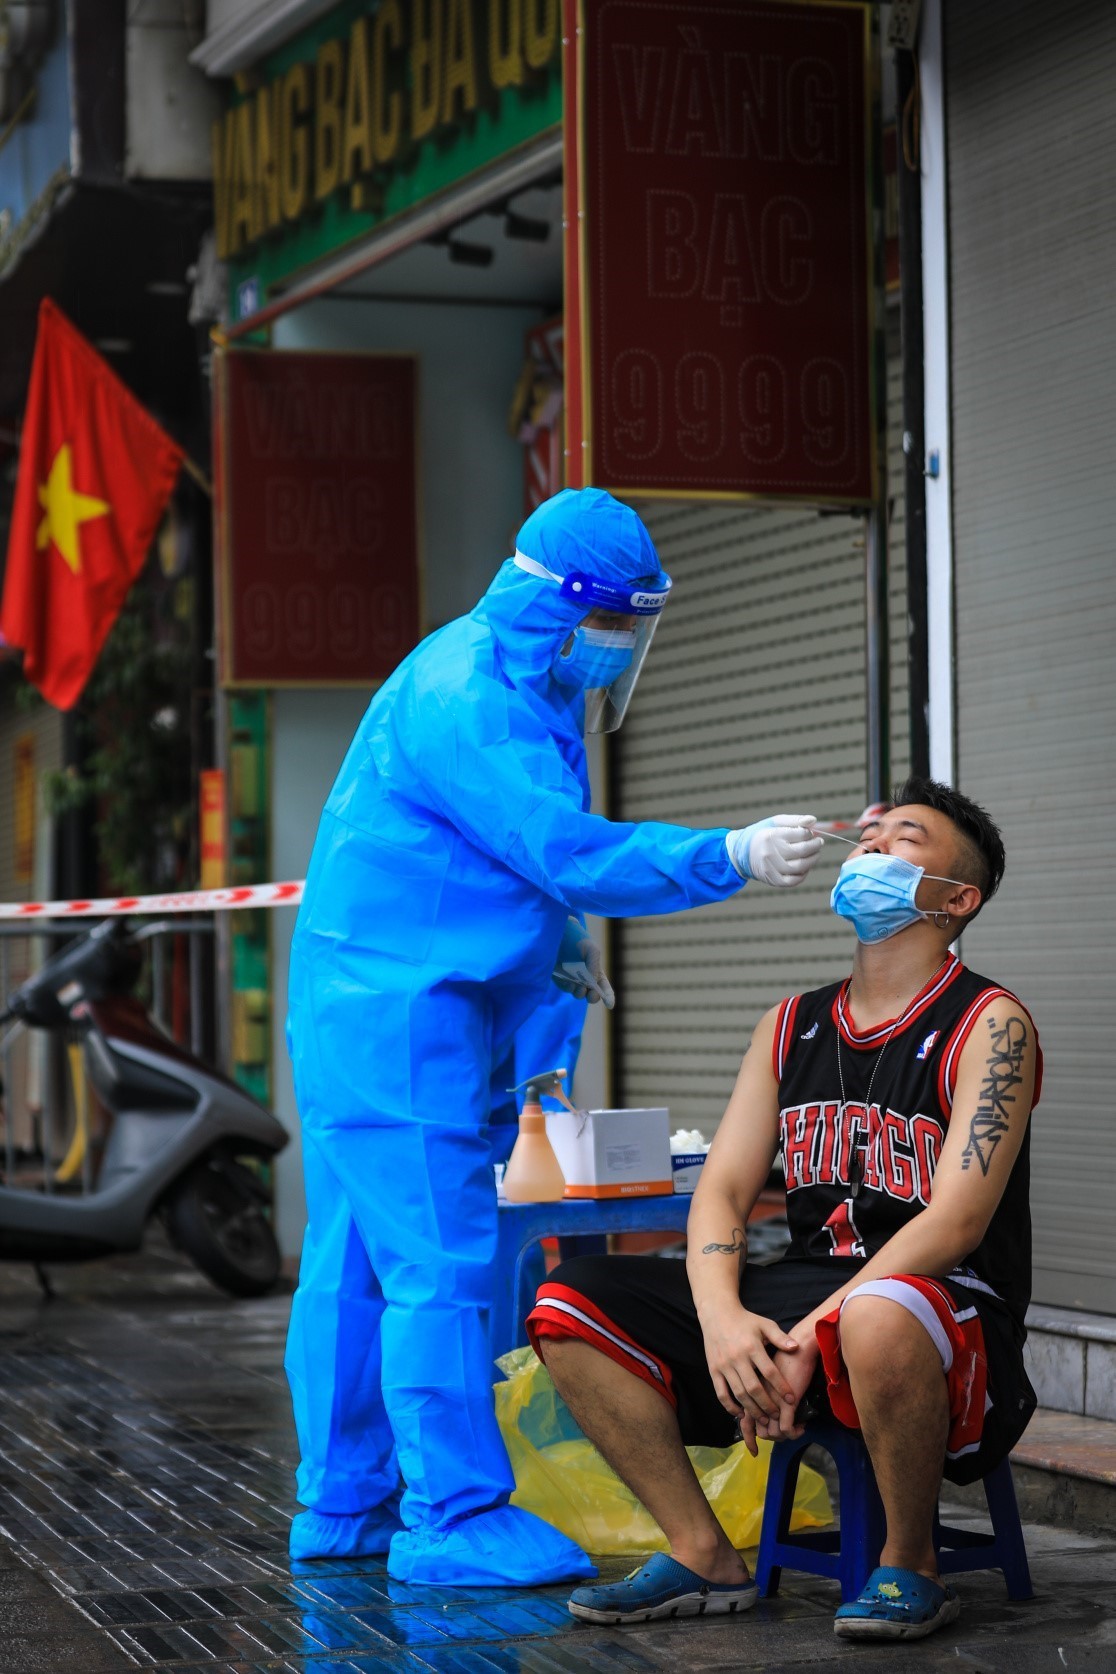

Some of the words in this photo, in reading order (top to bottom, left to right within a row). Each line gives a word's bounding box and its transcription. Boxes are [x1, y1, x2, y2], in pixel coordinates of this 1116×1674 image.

[316, 1, 402, 211] BẠC
[612, 25, 839, 165] VÀNG
[646, 188, 814, 327] BẠC
[611, 347, 849, 467] 9999
[242, 581, 409, 661] 9999
[636, 595, 660, 606] Face
[779, 1099, 946, 1207] HICAGO
[821, 1198, 866, 1258] 1
